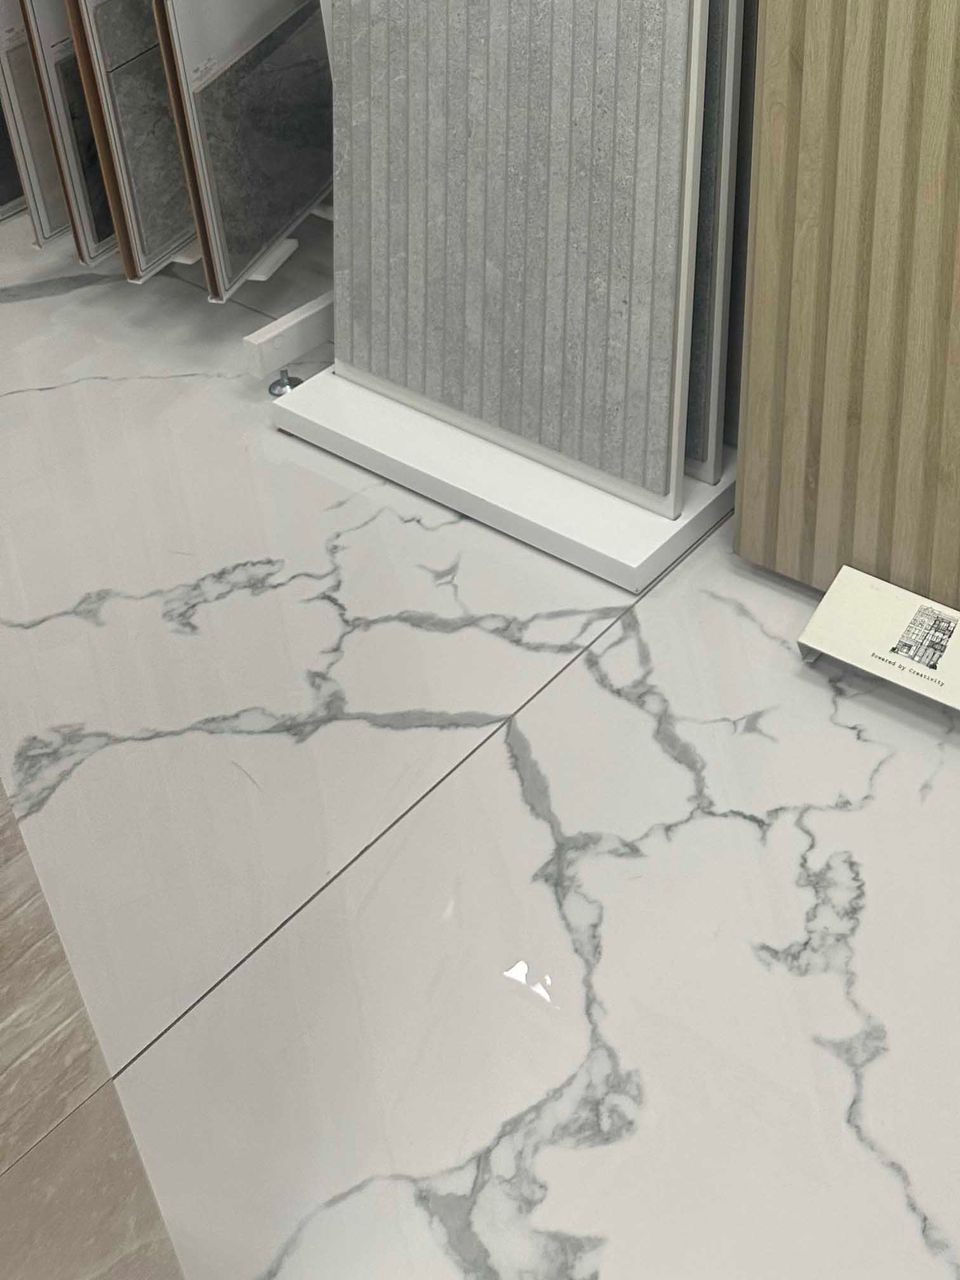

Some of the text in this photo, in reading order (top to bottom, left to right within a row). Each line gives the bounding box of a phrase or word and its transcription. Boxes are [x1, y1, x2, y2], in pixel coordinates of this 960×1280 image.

[871, 652, 944, 687] Powered by Creativity
